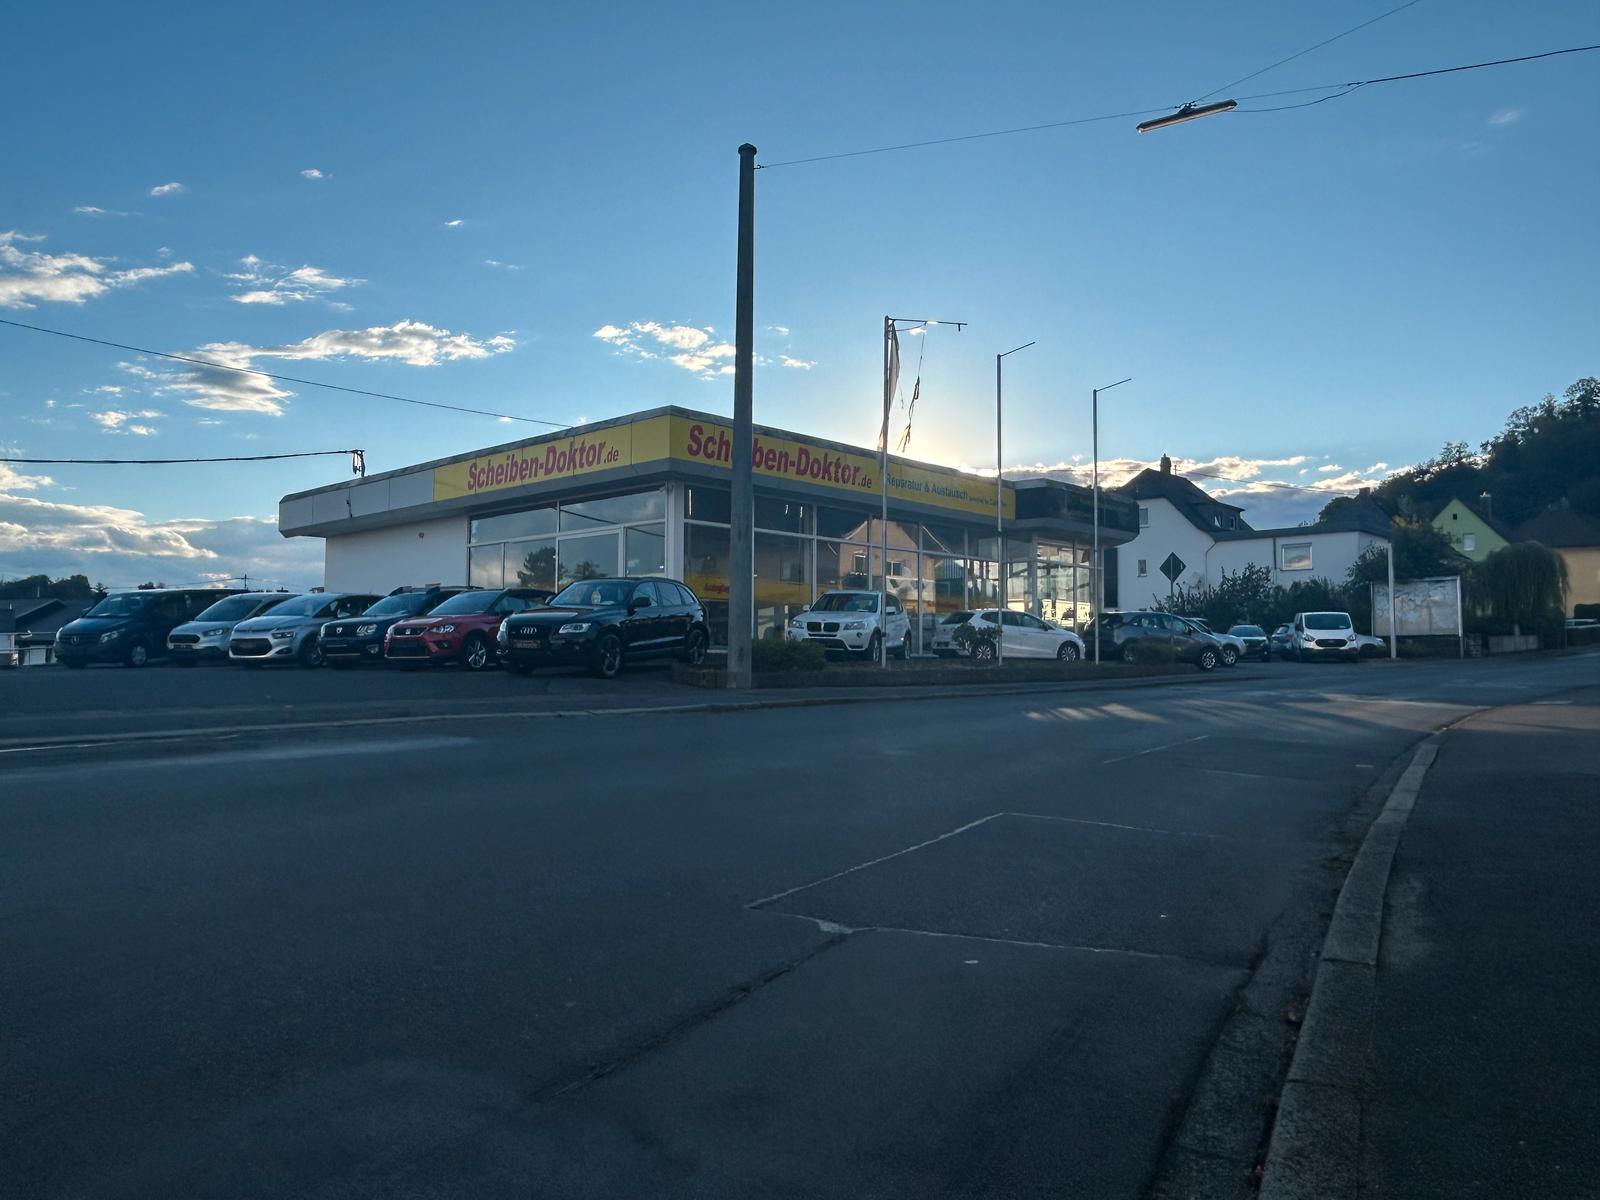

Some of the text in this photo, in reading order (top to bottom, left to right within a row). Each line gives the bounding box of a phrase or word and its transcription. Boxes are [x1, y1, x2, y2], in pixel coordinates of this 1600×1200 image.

[468, 439, 619, 490] Scheiben-Doktor.de
[687, 425, 872, 489] Schben-Doktor.de
[886, 473, 922, 491] Reparatur
[931, 483, 968, 500] Austausch
